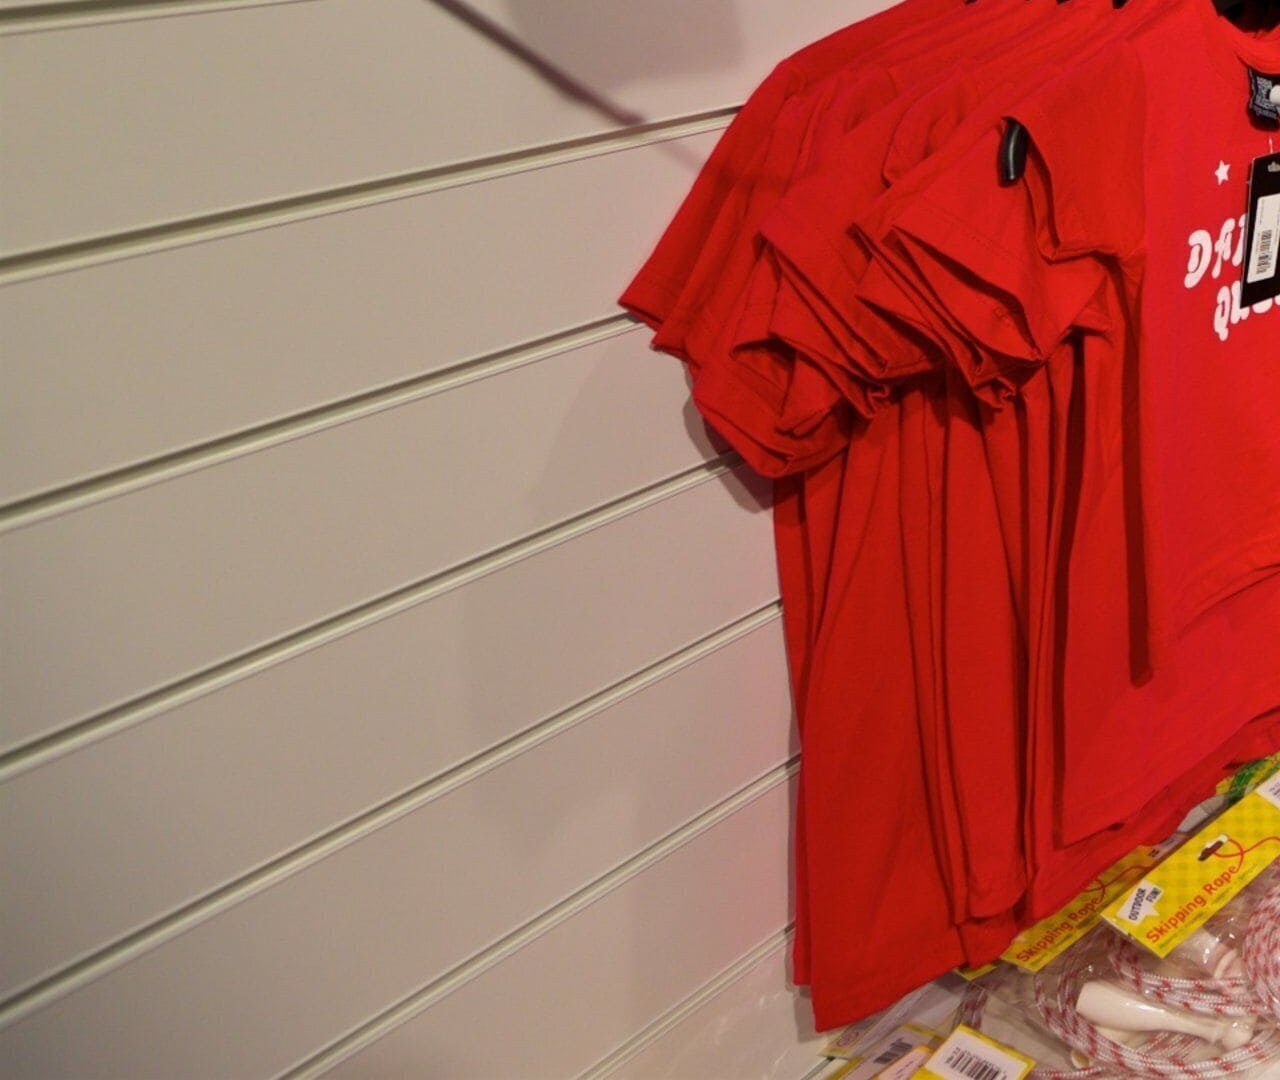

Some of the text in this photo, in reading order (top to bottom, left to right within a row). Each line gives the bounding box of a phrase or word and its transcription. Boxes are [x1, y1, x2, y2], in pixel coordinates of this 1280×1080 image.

[1128, 887, 1147, 921] OUTDOOR
[1145, 887, 1162, 903] FUN!
[1146, 864, 1240, 944] Skipping Rope
[1015, 896, 1099, 963] Skipping Rope
